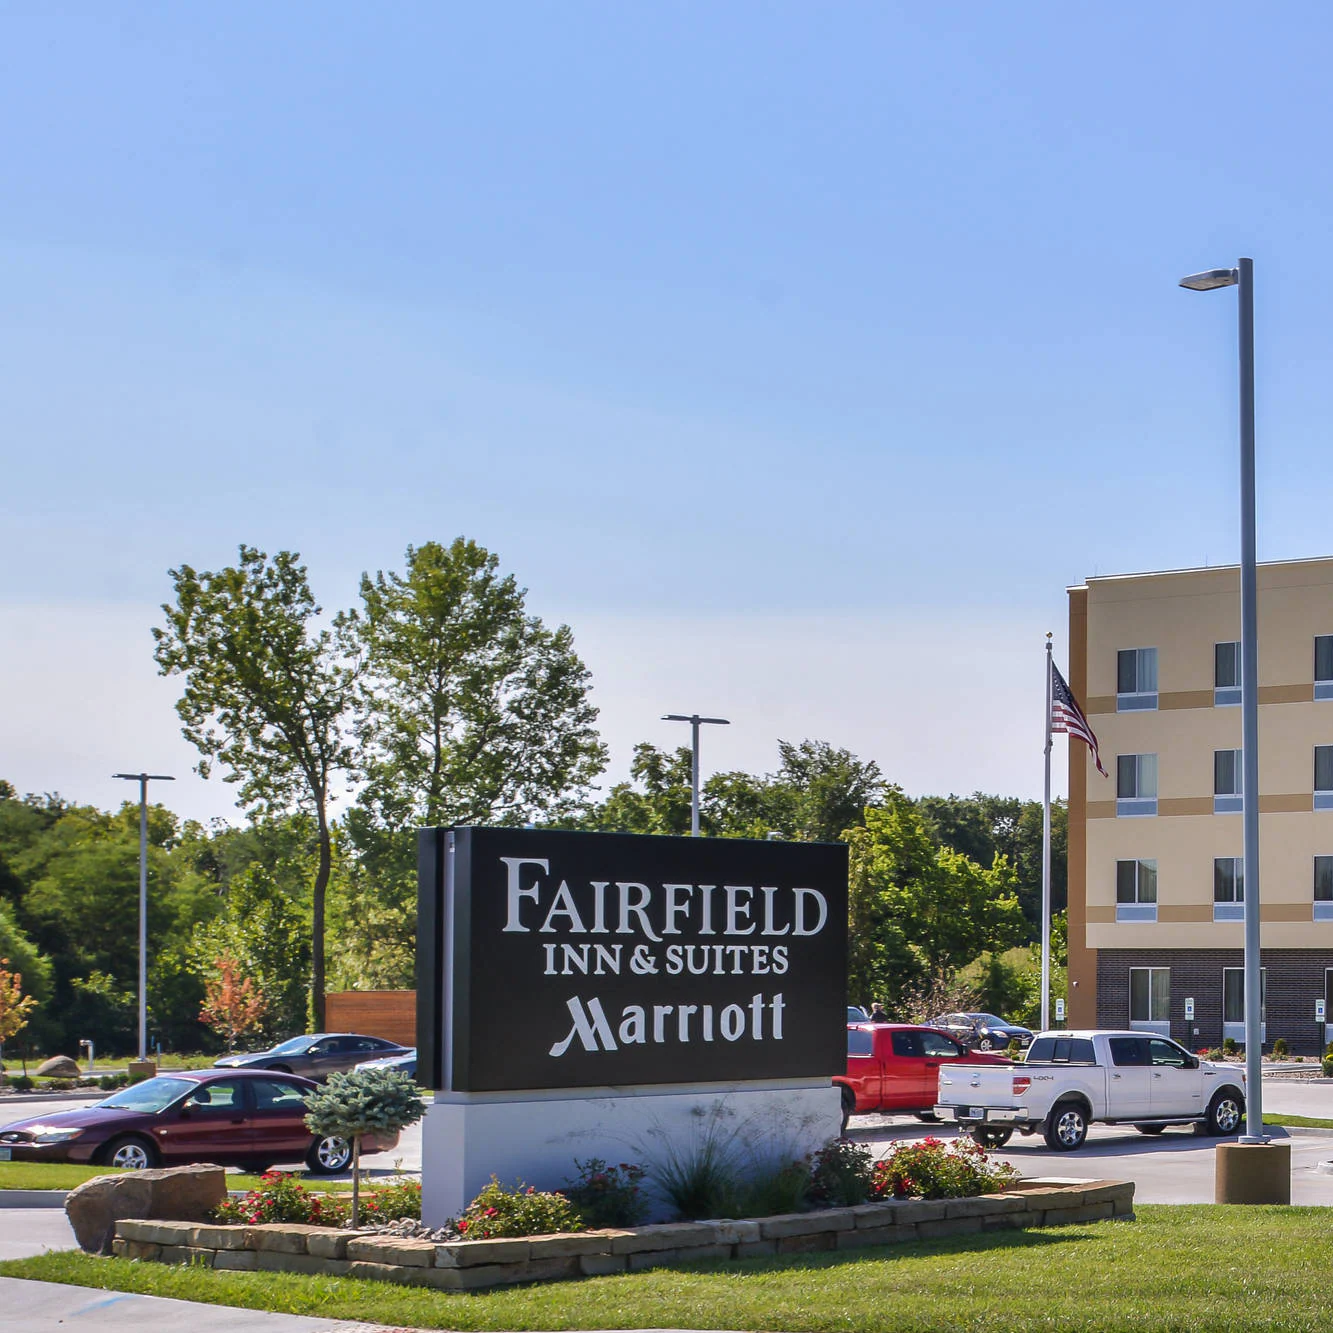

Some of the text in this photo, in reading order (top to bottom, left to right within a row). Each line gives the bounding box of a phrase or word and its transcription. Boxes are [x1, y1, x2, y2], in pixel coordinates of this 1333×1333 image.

[500, 857, 828, 942] FAIRFIELD
[543, 943, 789, 975] INN & SUITES
[549, 992, 787, 1057] Marriott
